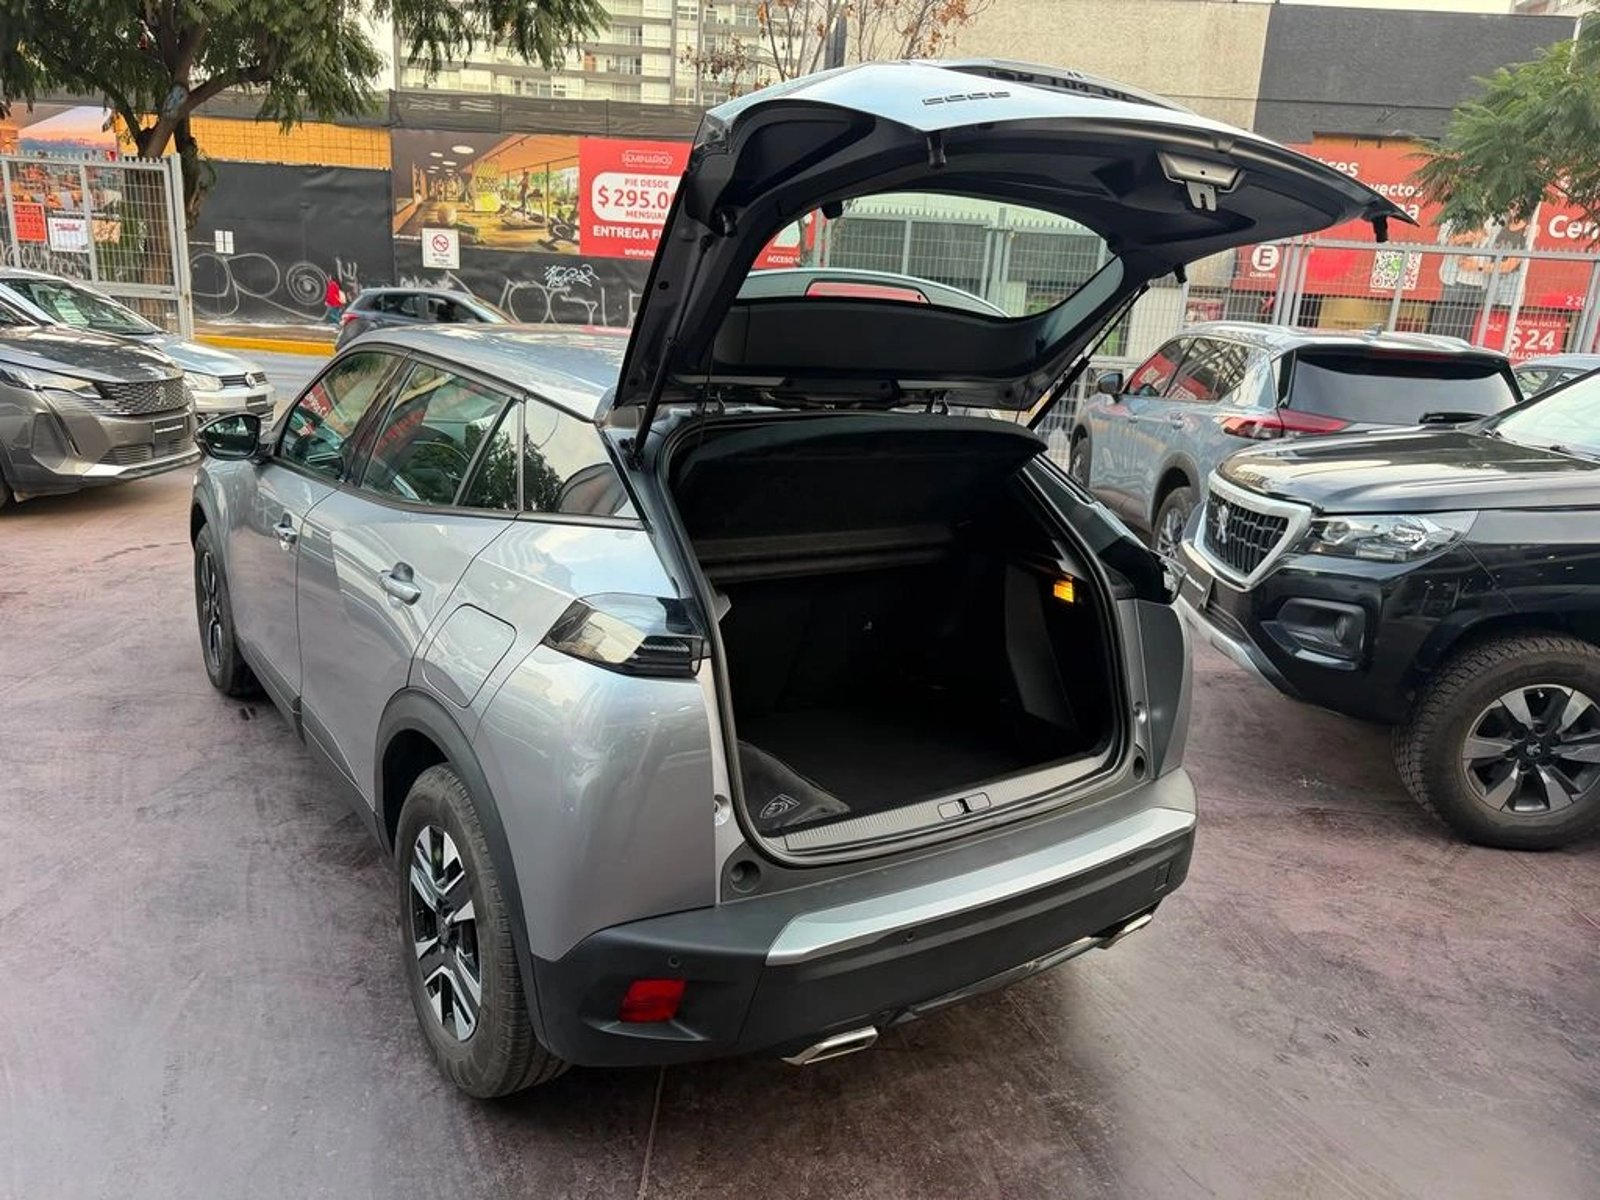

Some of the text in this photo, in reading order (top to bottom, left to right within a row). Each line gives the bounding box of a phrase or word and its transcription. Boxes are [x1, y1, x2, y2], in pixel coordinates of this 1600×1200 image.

[624, 178, 669, 188] PIE DESDE
[593, 225, 650, 240] ENTREGA
